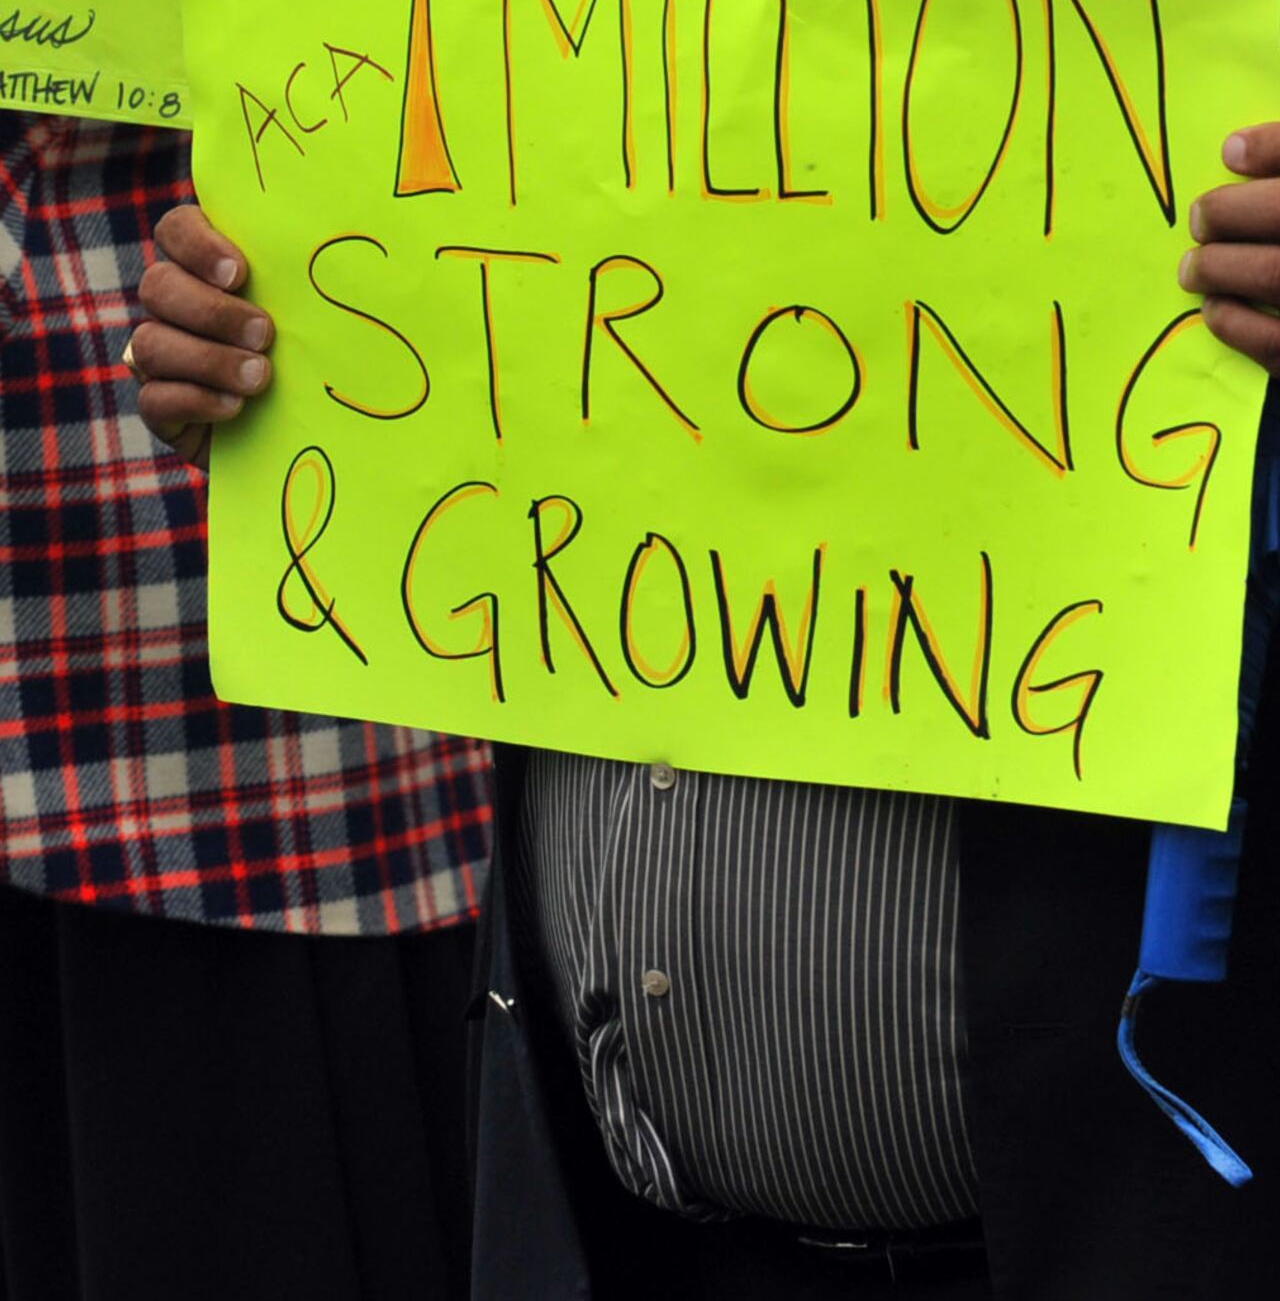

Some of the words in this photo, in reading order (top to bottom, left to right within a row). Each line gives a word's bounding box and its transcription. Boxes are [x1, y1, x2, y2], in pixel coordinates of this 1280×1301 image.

[118, 80, 182, 119] 10:8
[235, 42, 395, 193] ACA
[308, 234, 1222, 551] STRONG
[276, 446, 368, 665] &
[401, 481, 1104, 781] GROWING
